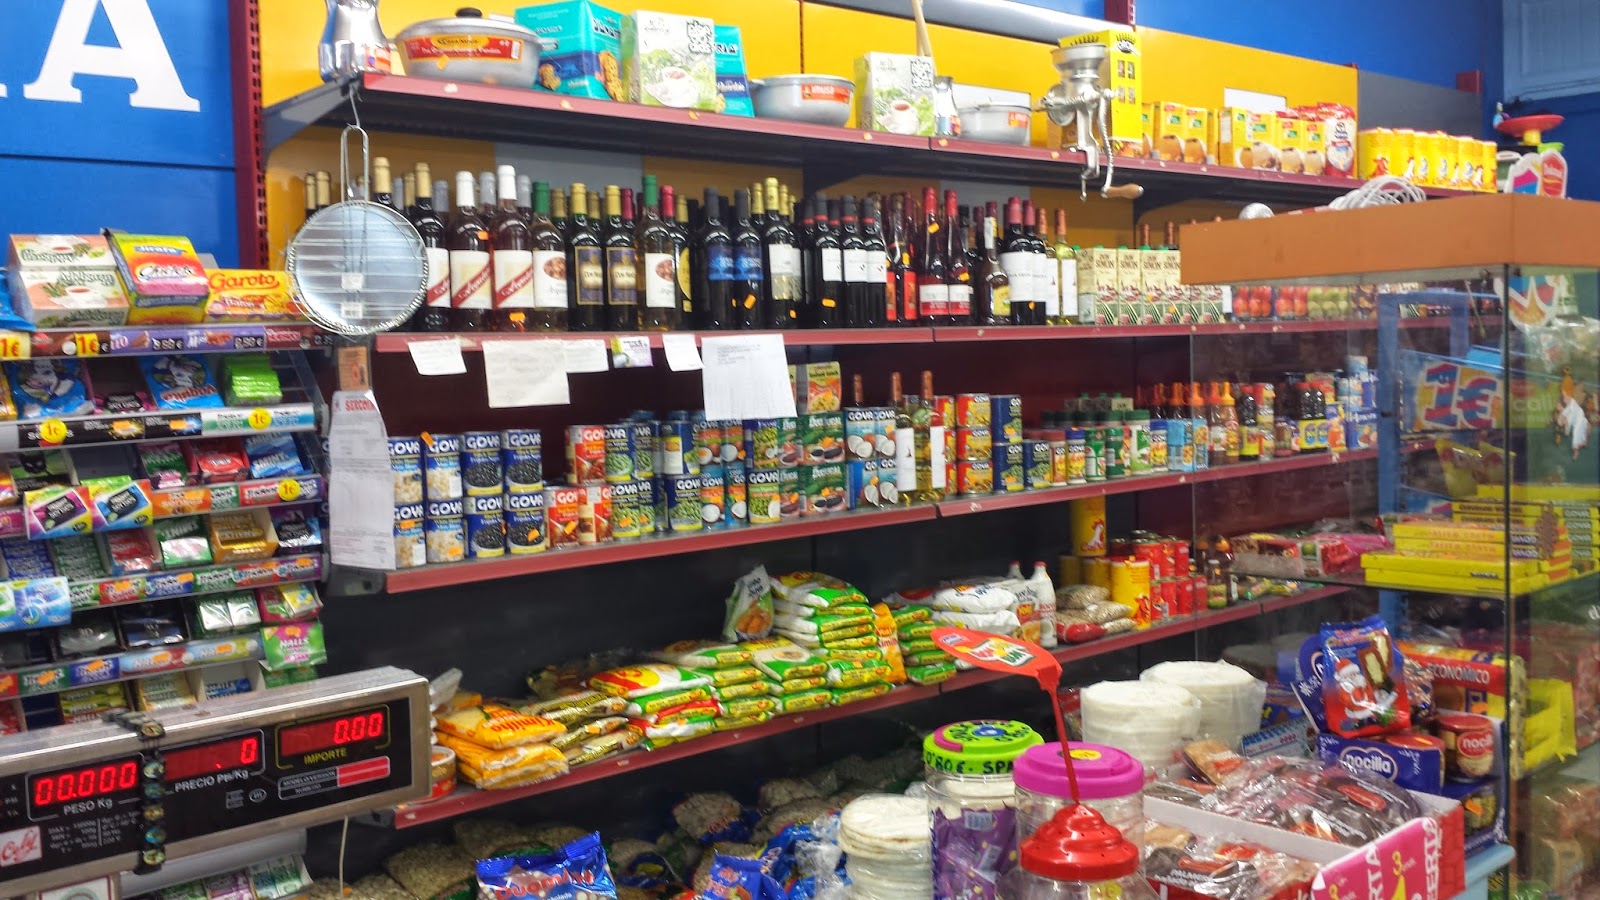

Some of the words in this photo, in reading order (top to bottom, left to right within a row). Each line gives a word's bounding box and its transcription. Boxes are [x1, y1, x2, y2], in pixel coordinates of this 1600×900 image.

[0, 0, 200, 112] A
[209, 274, 281, 290] Garoto
[1423, 363, 1499, 430] 1€
[280, 637, 310, 649] HALLS
[333, 712, 383, 744] 0.00
[240, 738, 258, 764] 0
[304, 747, 348, 765] IMPORTE
[1345, 754, 1392, 774] nocilla
[34, 761, 138, 806] 00.000
[175, 776, 215, 792] PRECIO
[63, 800, 95, 815] PESO
[98, 798, 113, 809] Kg
